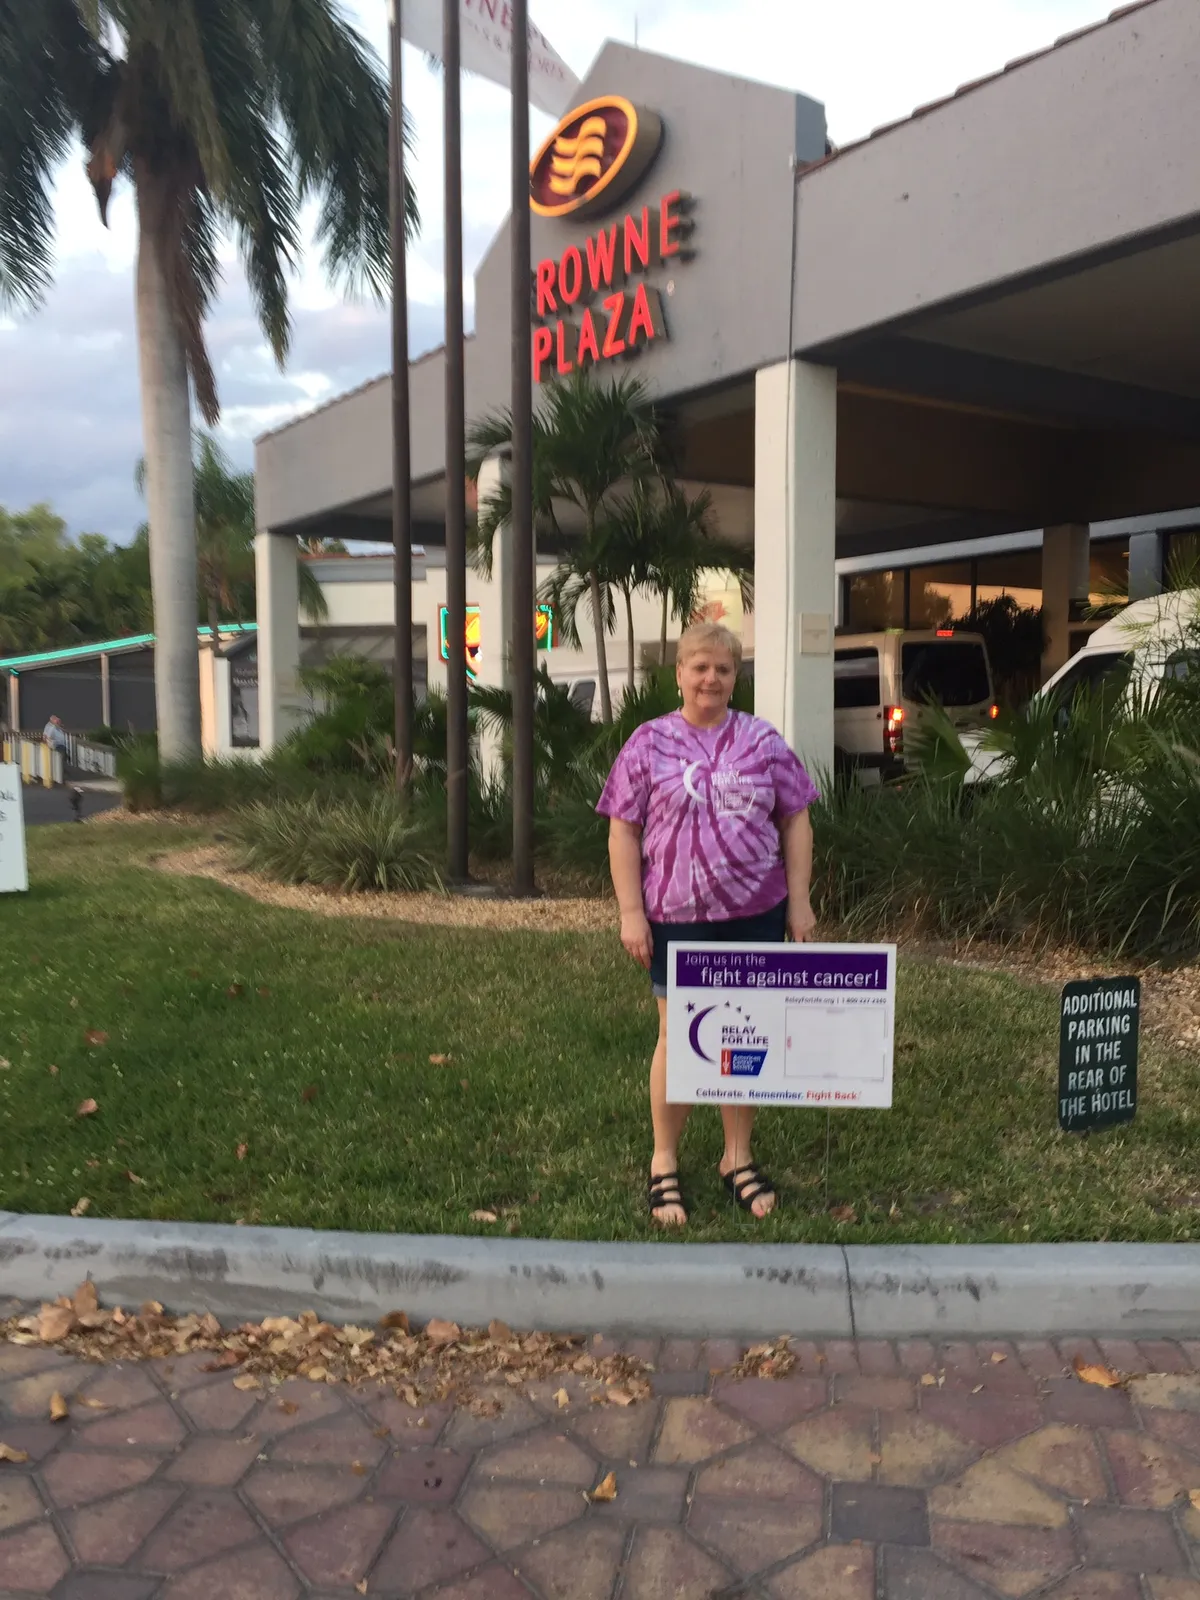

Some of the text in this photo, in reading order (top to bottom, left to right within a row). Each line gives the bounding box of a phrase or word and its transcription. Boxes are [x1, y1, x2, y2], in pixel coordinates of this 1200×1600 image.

[532, 282, 655, 383] PLAZA
[685, 953, 766, 966] Join us in the
[701, 966, 879, 988] fight against cancer!
[1063, 989, 1138, 1016] ADDITIONAL
[722, 1025, 757, 1035] RELAY
[1068, 1014, 1131, 1041] PARKING
[722, 1035, 769, 1045] FOR LIFE
[1075, 1041, 1122, 1065] IN THE
[1068, 1065, 1127, 1092] REAR OF
[806, 1090, 832, 1102] Fight
[1060, 1089, 1134, 1119] THE HOTEL
